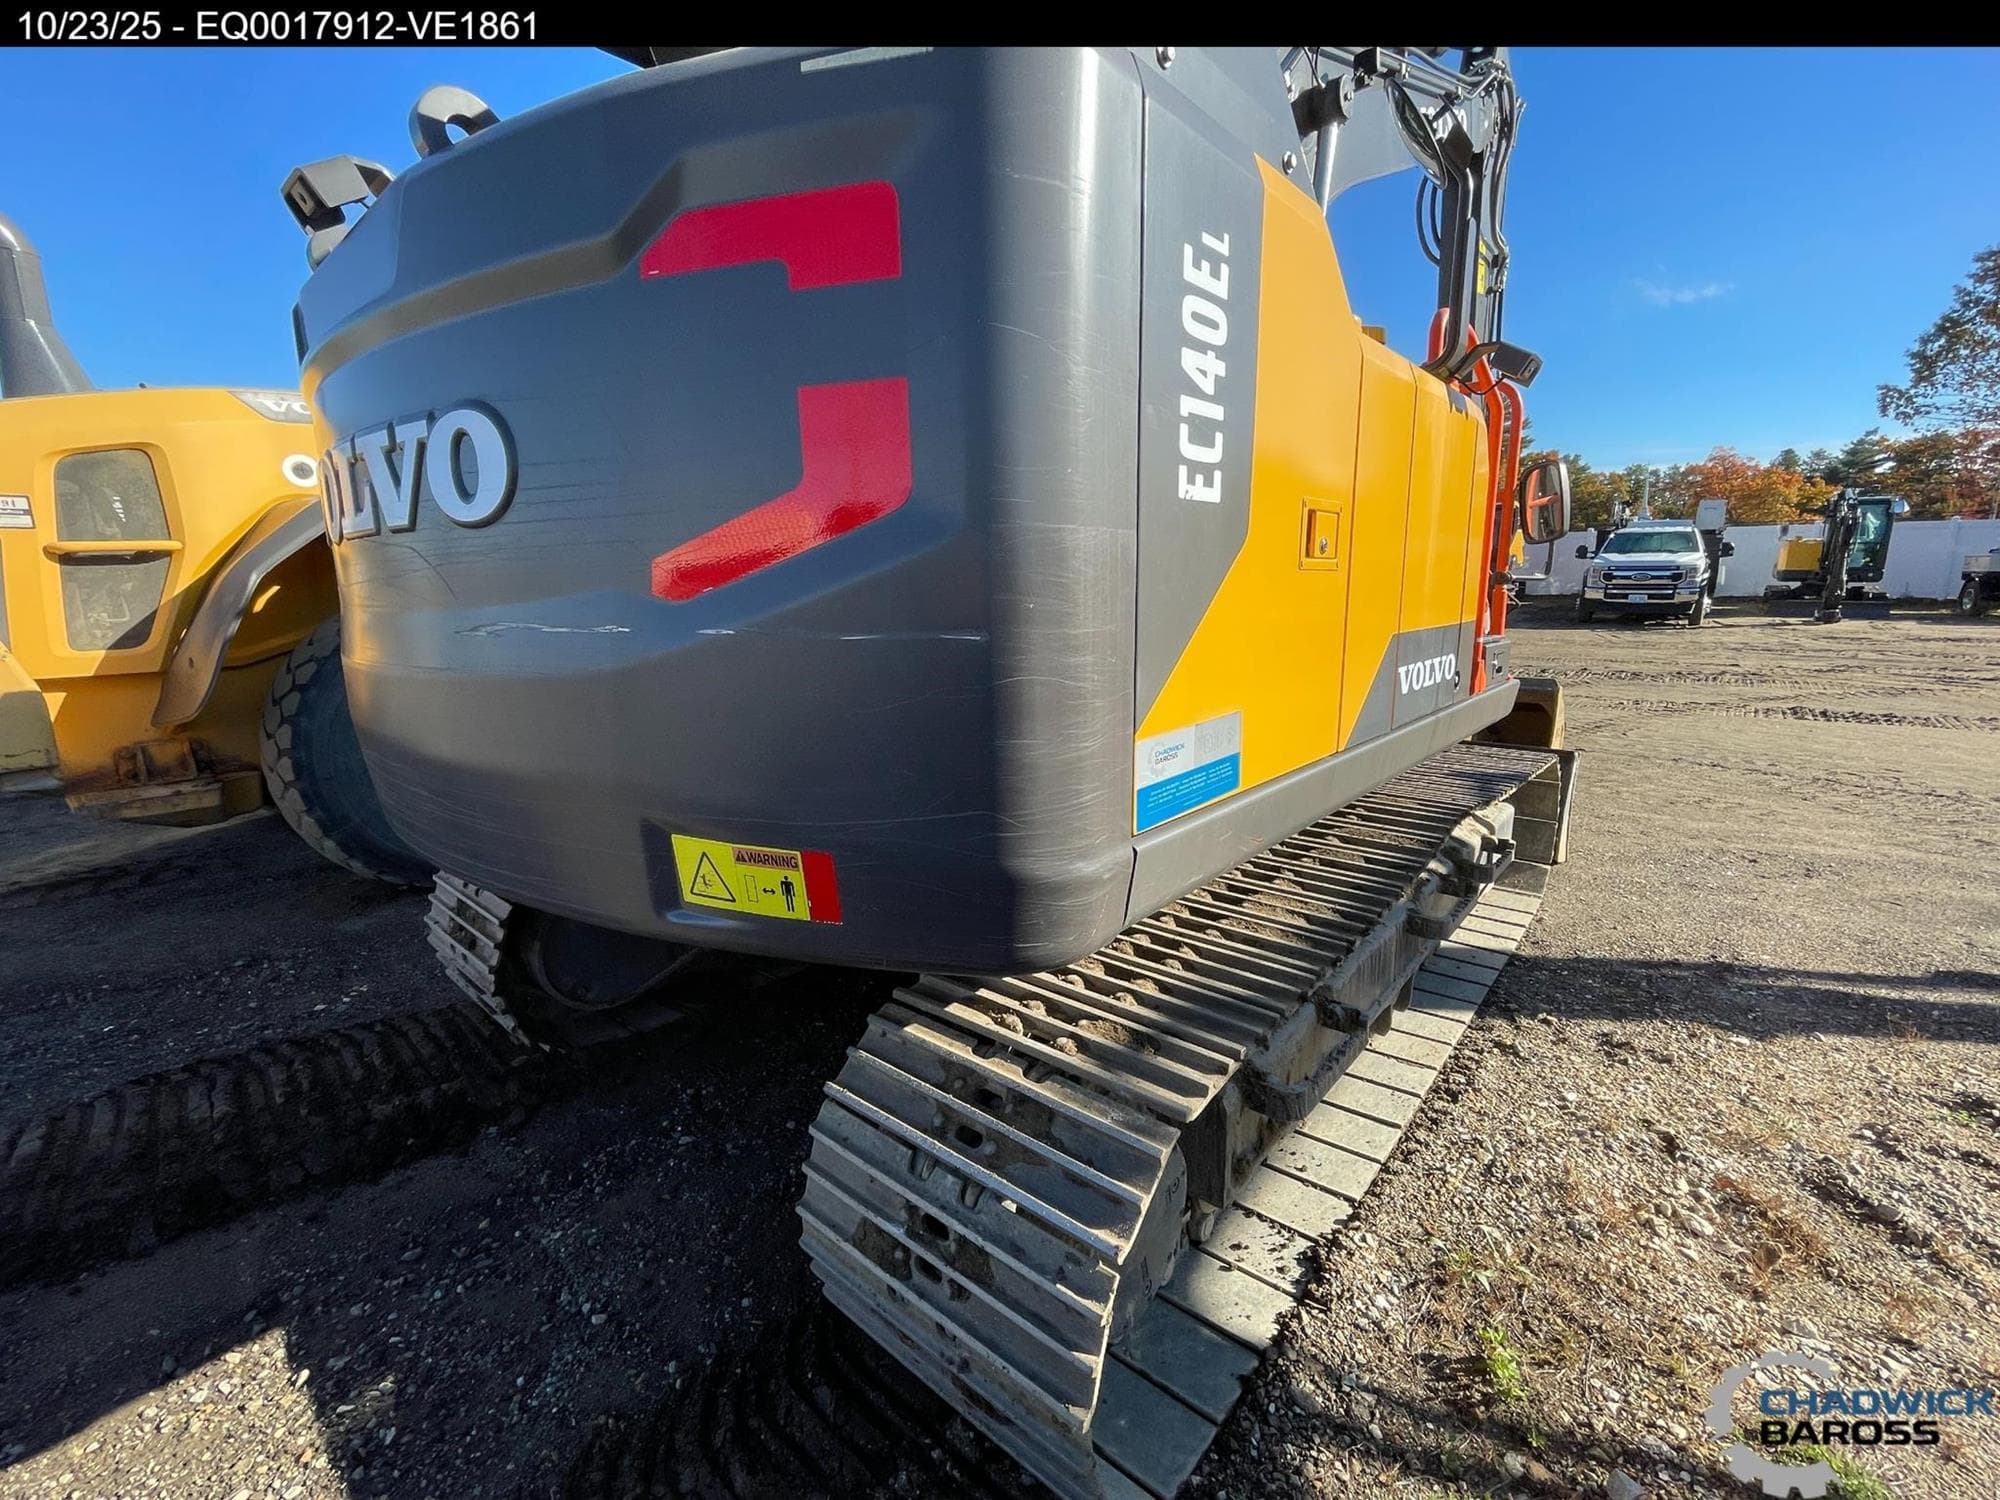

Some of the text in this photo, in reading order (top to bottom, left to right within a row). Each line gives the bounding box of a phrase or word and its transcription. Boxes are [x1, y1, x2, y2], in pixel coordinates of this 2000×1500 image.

[318, 404, 515, 545] OLVO
[1398, 653, 1457, 695] VOLVO
[746, 851, 798, 868] WARNING
